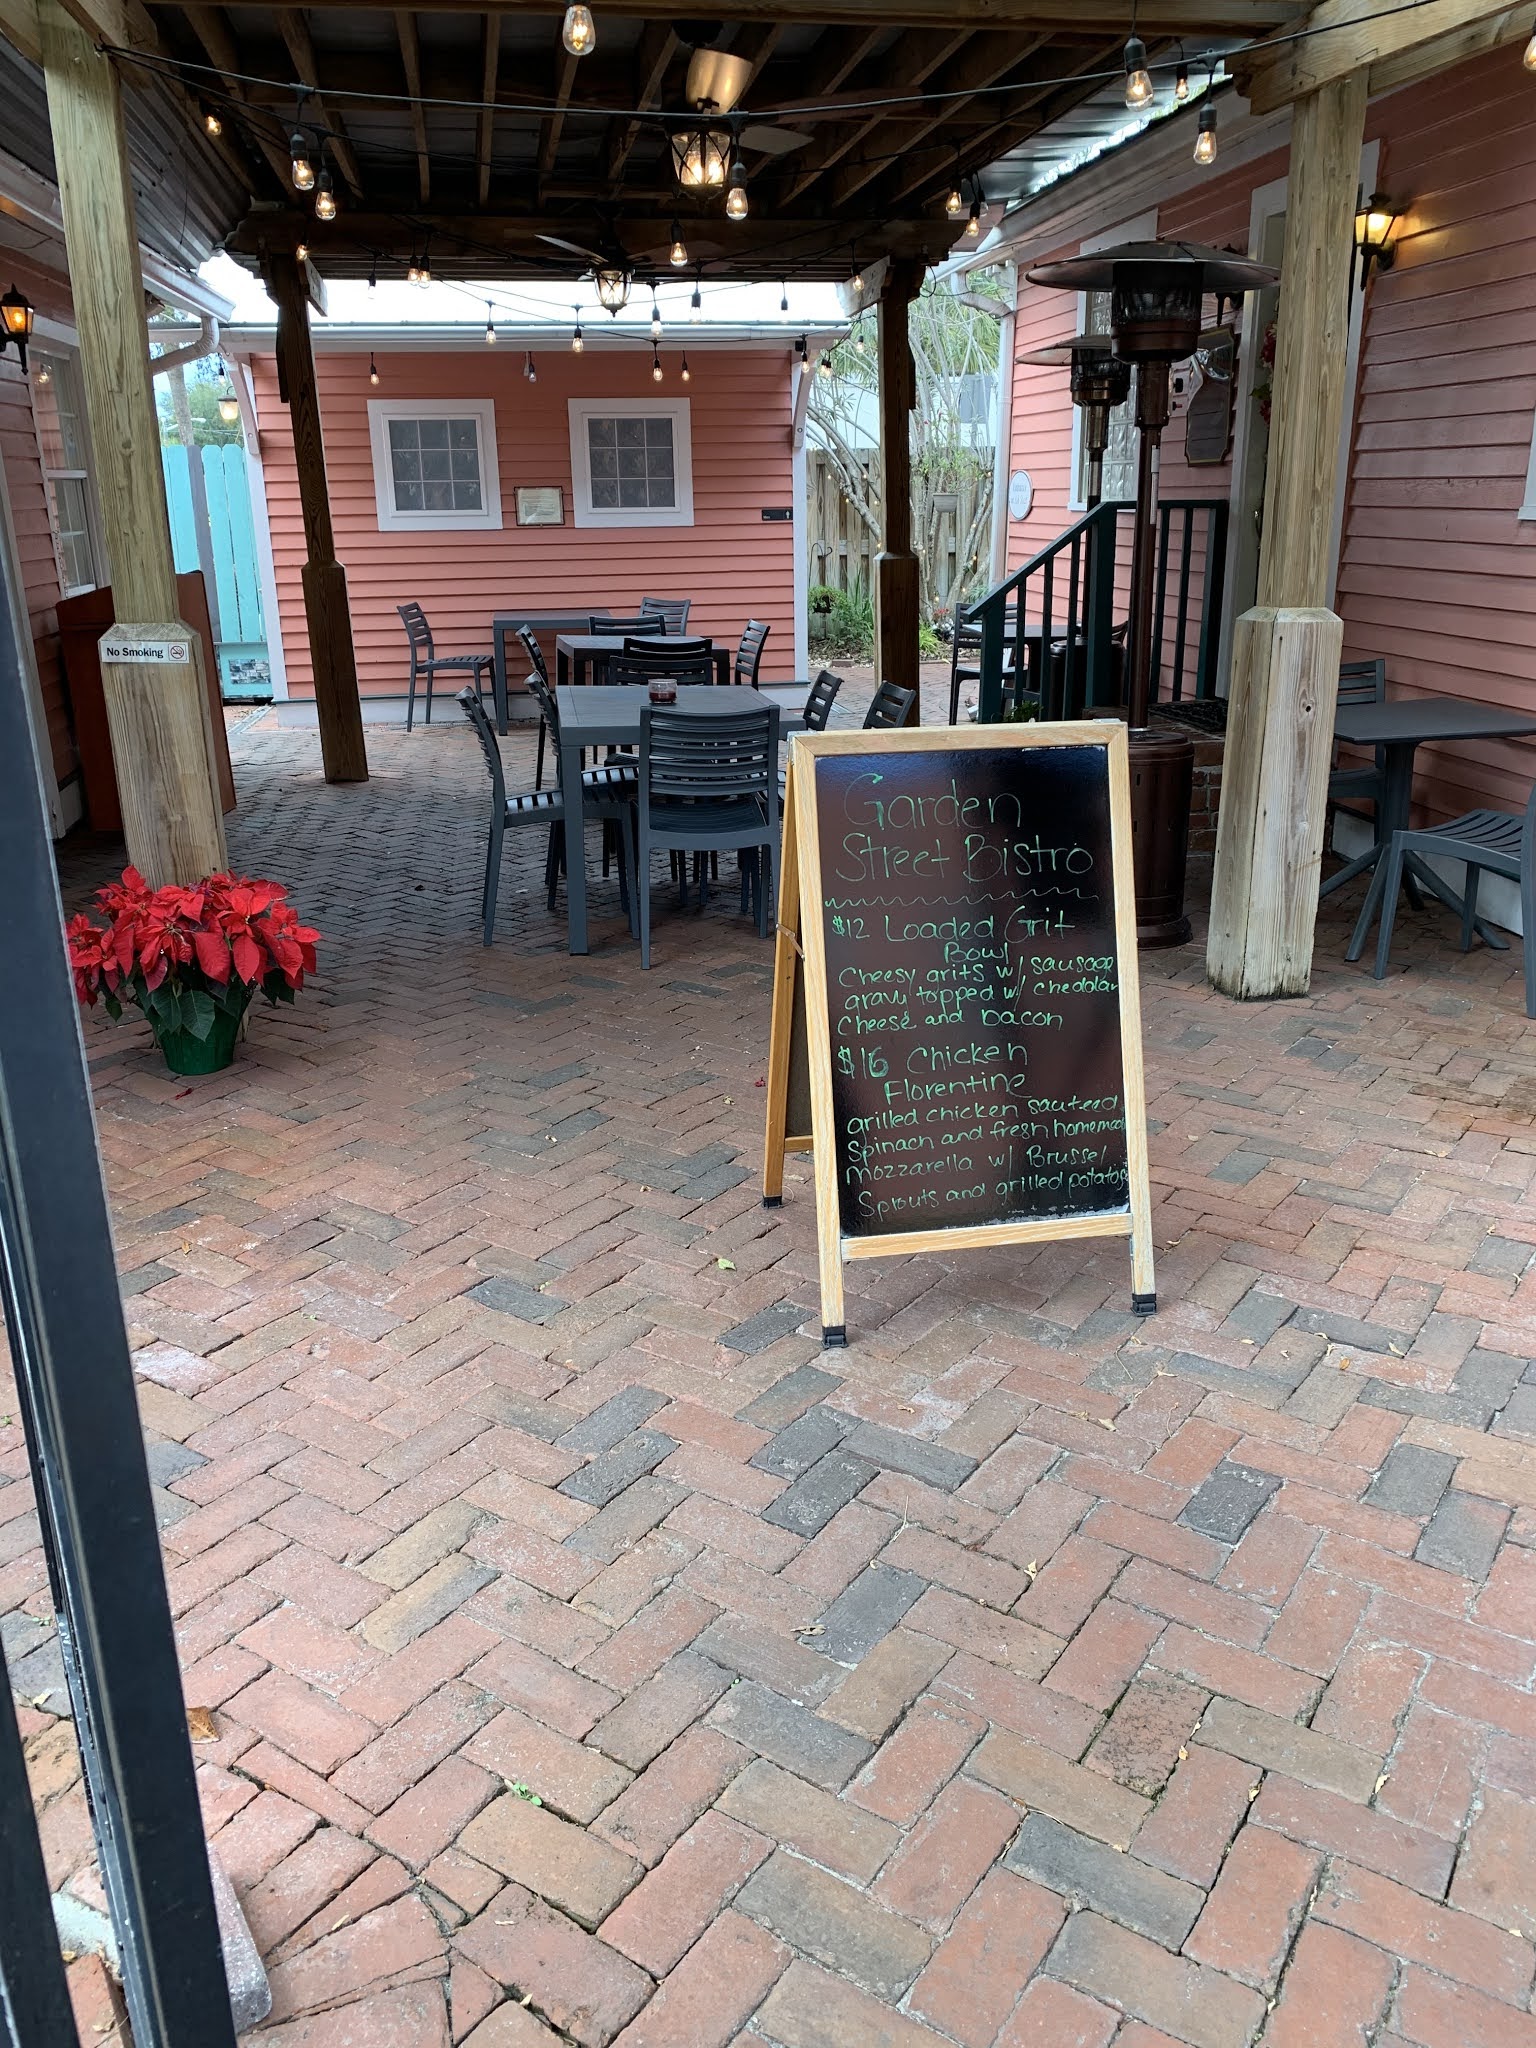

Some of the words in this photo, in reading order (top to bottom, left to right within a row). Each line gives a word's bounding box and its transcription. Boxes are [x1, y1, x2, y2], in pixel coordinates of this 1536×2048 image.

[106, 647, 120, 657] No
[122, 647, 164, 659] Smoking
[844, 773, 1021, 830] Garden
[835, 832, 950, 882] Street
[962, 833, 1093, 884] Bistro
[832, 915, 869, 939] $12
[885, 914, 994, 941] Loaded
[1004, 905, 1075, 943] Grit
[943, 942, 1009, 964] Bowl
[844, 989, 907, 1015] gravy
[917, 985, 994, 1012] topped
[1033, 975, 1118, 996] cheddar
[926, 963, 984, 994] grits
[925, 1010, 964, 1024] and
[981, 1009, 1063, 1030] bacon
[838, 1046, 889, 1079] $16
[907, 1042, 1028, 1075] Chicken
[884, 1071, 1032, 1105] Florentine
[847, 1110, 920, 1147] grilled
[926, 1101, 1018, 1123] chicken
[1027, 1095, 1118, 1113] sauteed
[941, 1125, 983, 1147] and
[990, 1120, 1048, 1142] fresh
[1026, 1145, 1107, 1168] Brussel
[858, 1189, 940, 1221] Sprouts
[946, 1182, 986, 1200] and
[995, 1171, 1063, 1205] grilled
